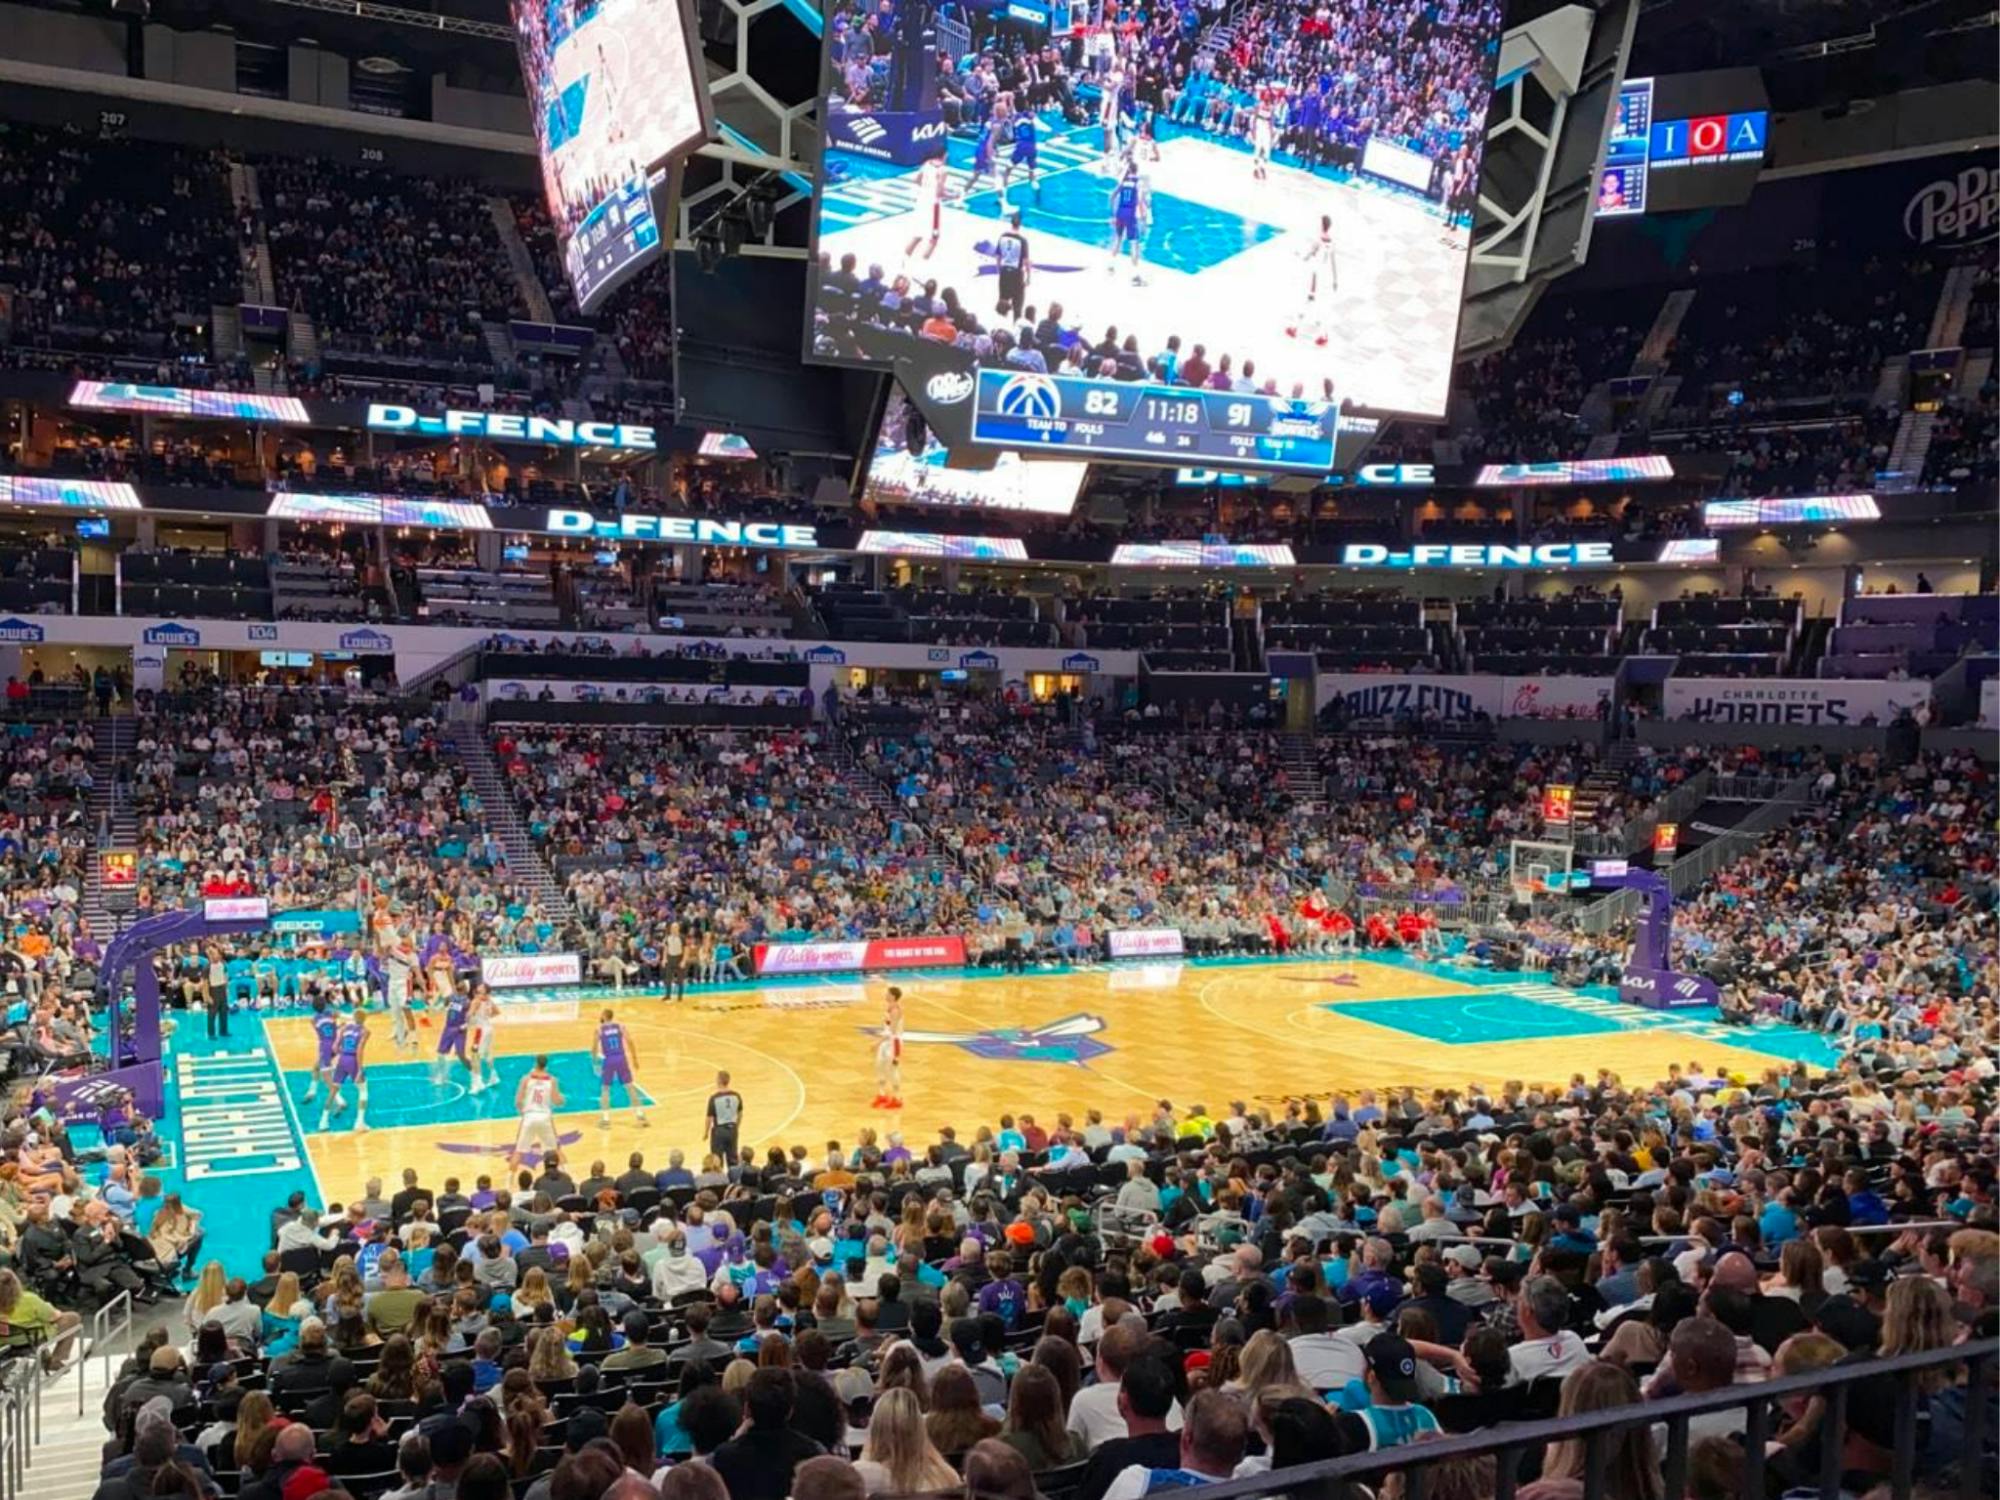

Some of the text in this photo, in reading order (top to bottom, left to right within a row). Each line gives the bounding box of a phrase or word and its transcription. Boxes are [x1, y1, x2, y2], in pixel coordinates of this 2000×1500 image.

[1085, 390, 1119, 415] 82
[1147, 400, 1199, 424] 11:18
[367, 404, 657, 448] D-FENCE
[1028, 418, 1051, 431] TEAM
[1227, 403, 1253, 427] 91
[547, 509, 818, 547] D-FENCE
[1343, 543, 1613, 565] D-FENCE
[1722, 689, 1819, 700] CHARLOTTE
[273, 919, 325, 931] GEICO
